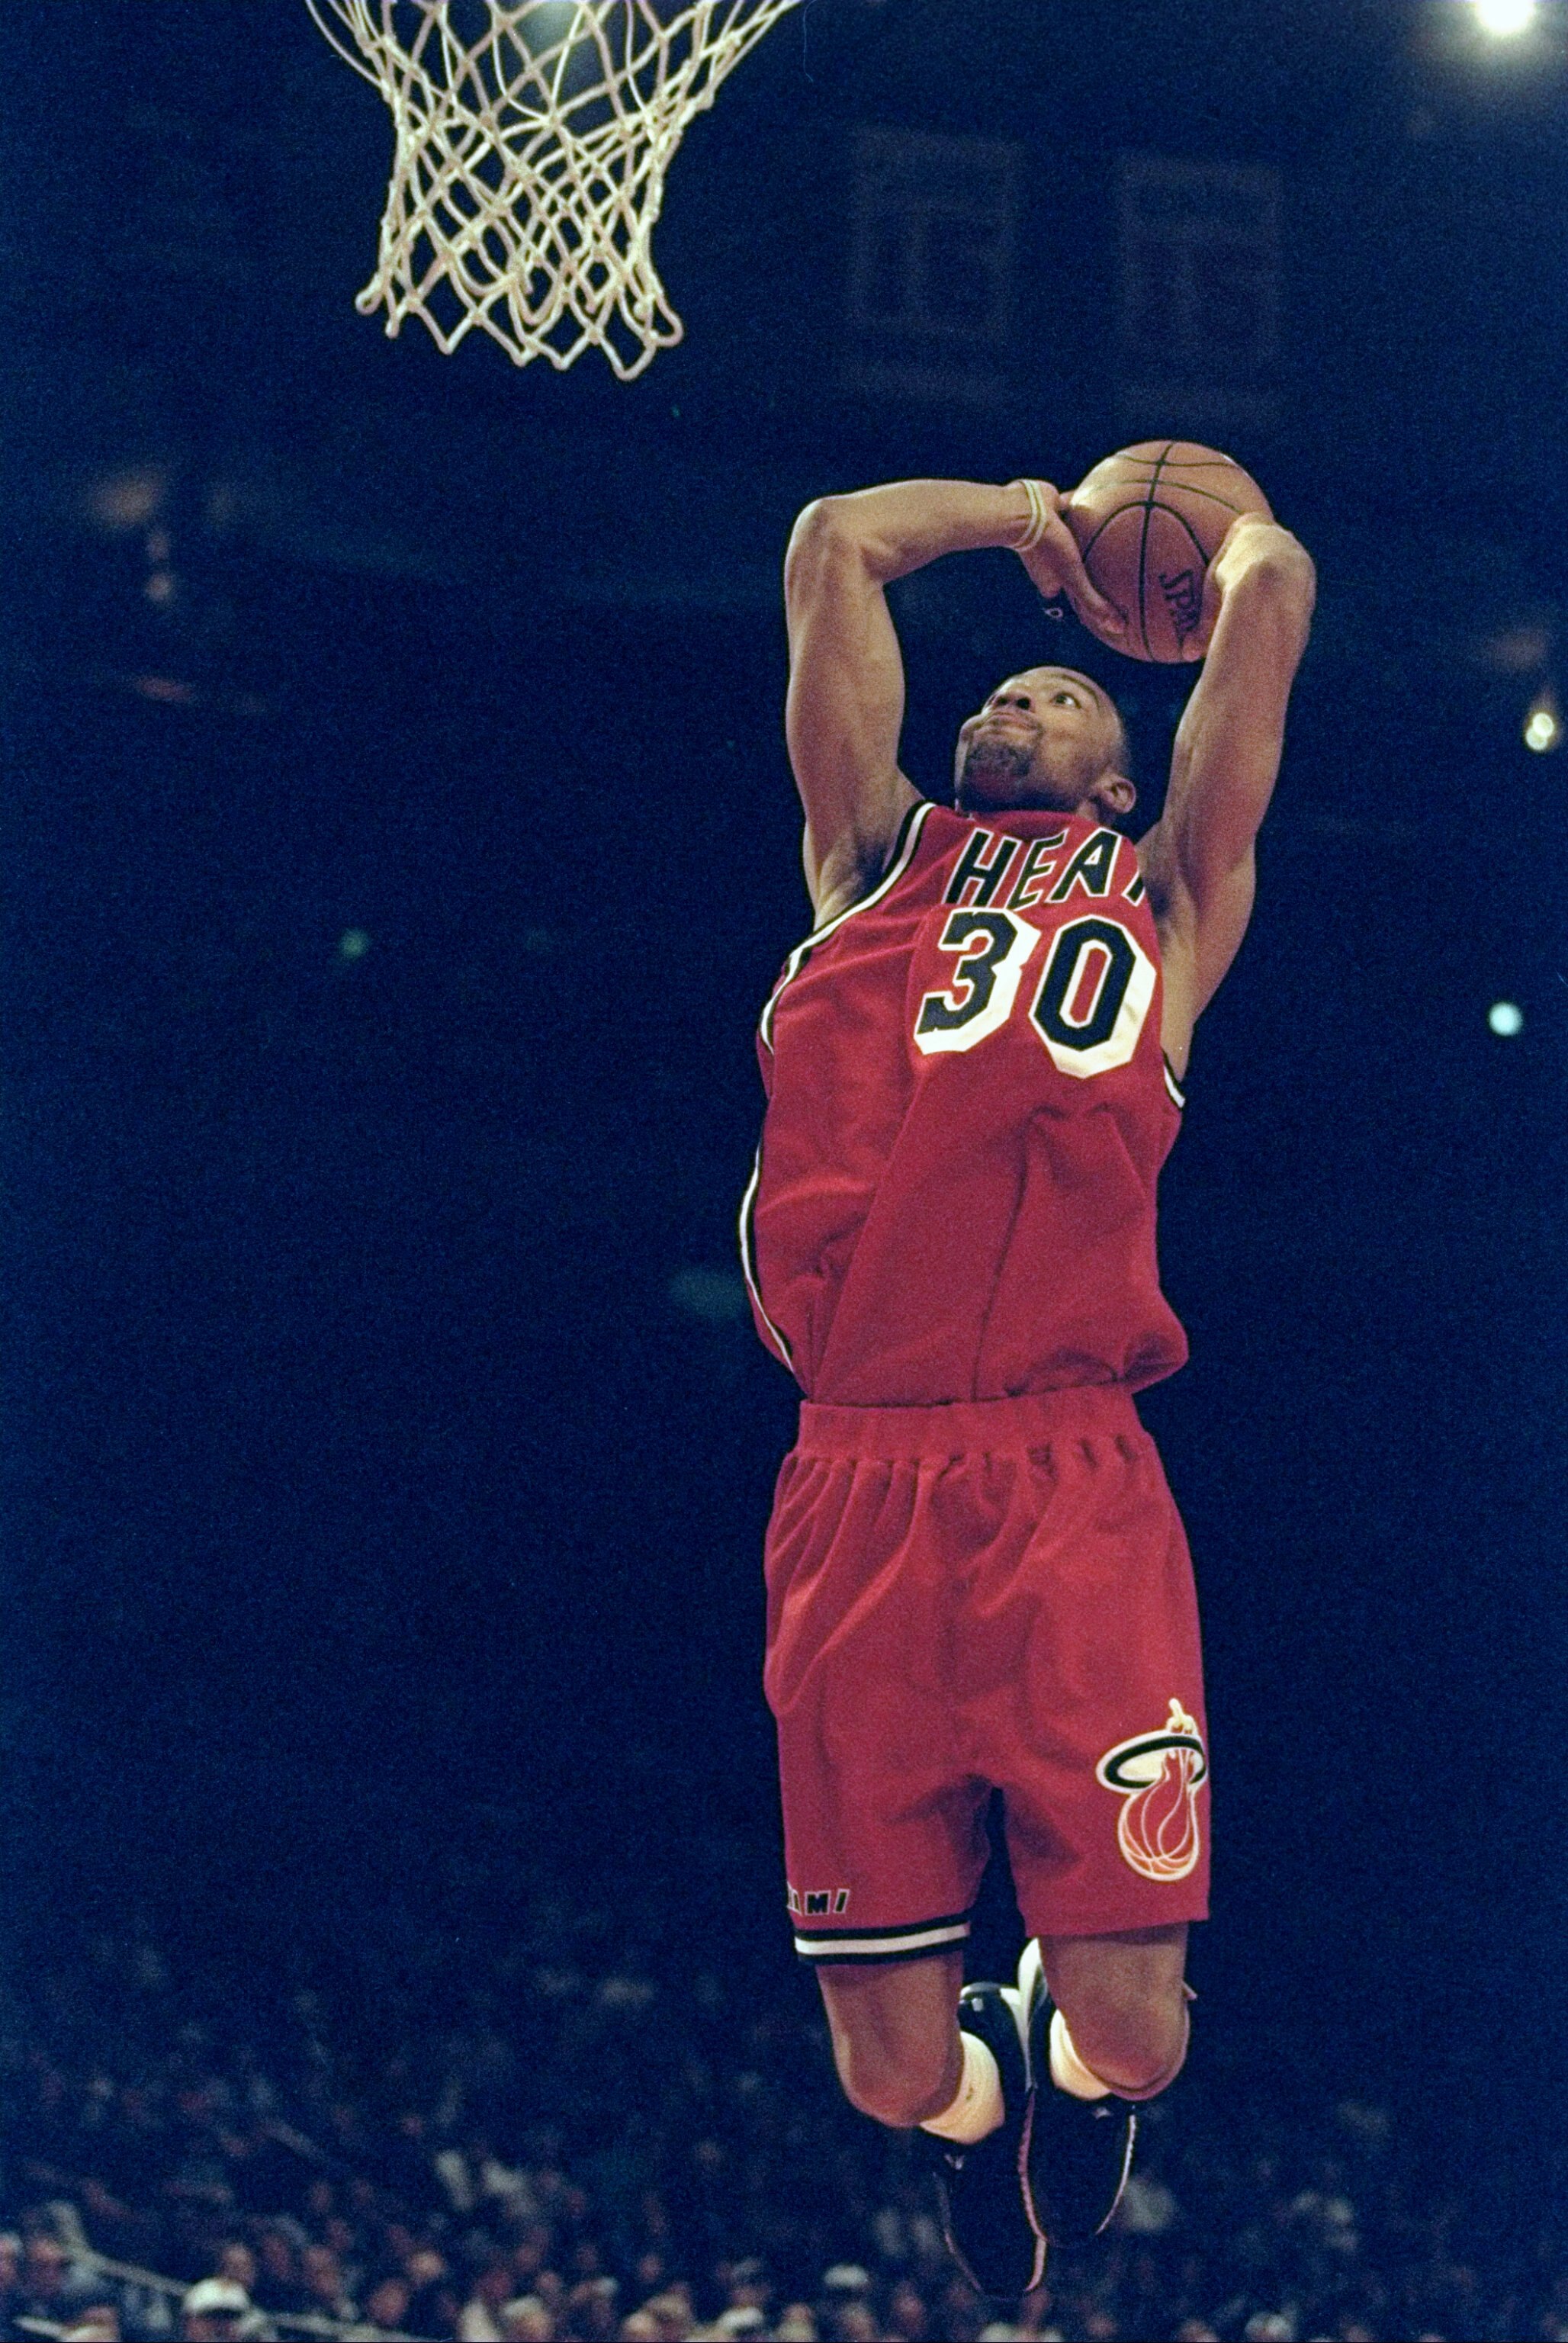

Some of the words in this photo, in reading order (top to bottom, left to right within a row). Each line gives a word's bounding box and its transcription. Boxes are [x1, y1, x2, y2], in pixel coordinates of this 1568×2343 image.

[1158, 569, 1203, 633] SPA
[942, 827, 1146, 911] HEA
[913, 906, 1157, 1079] 30
